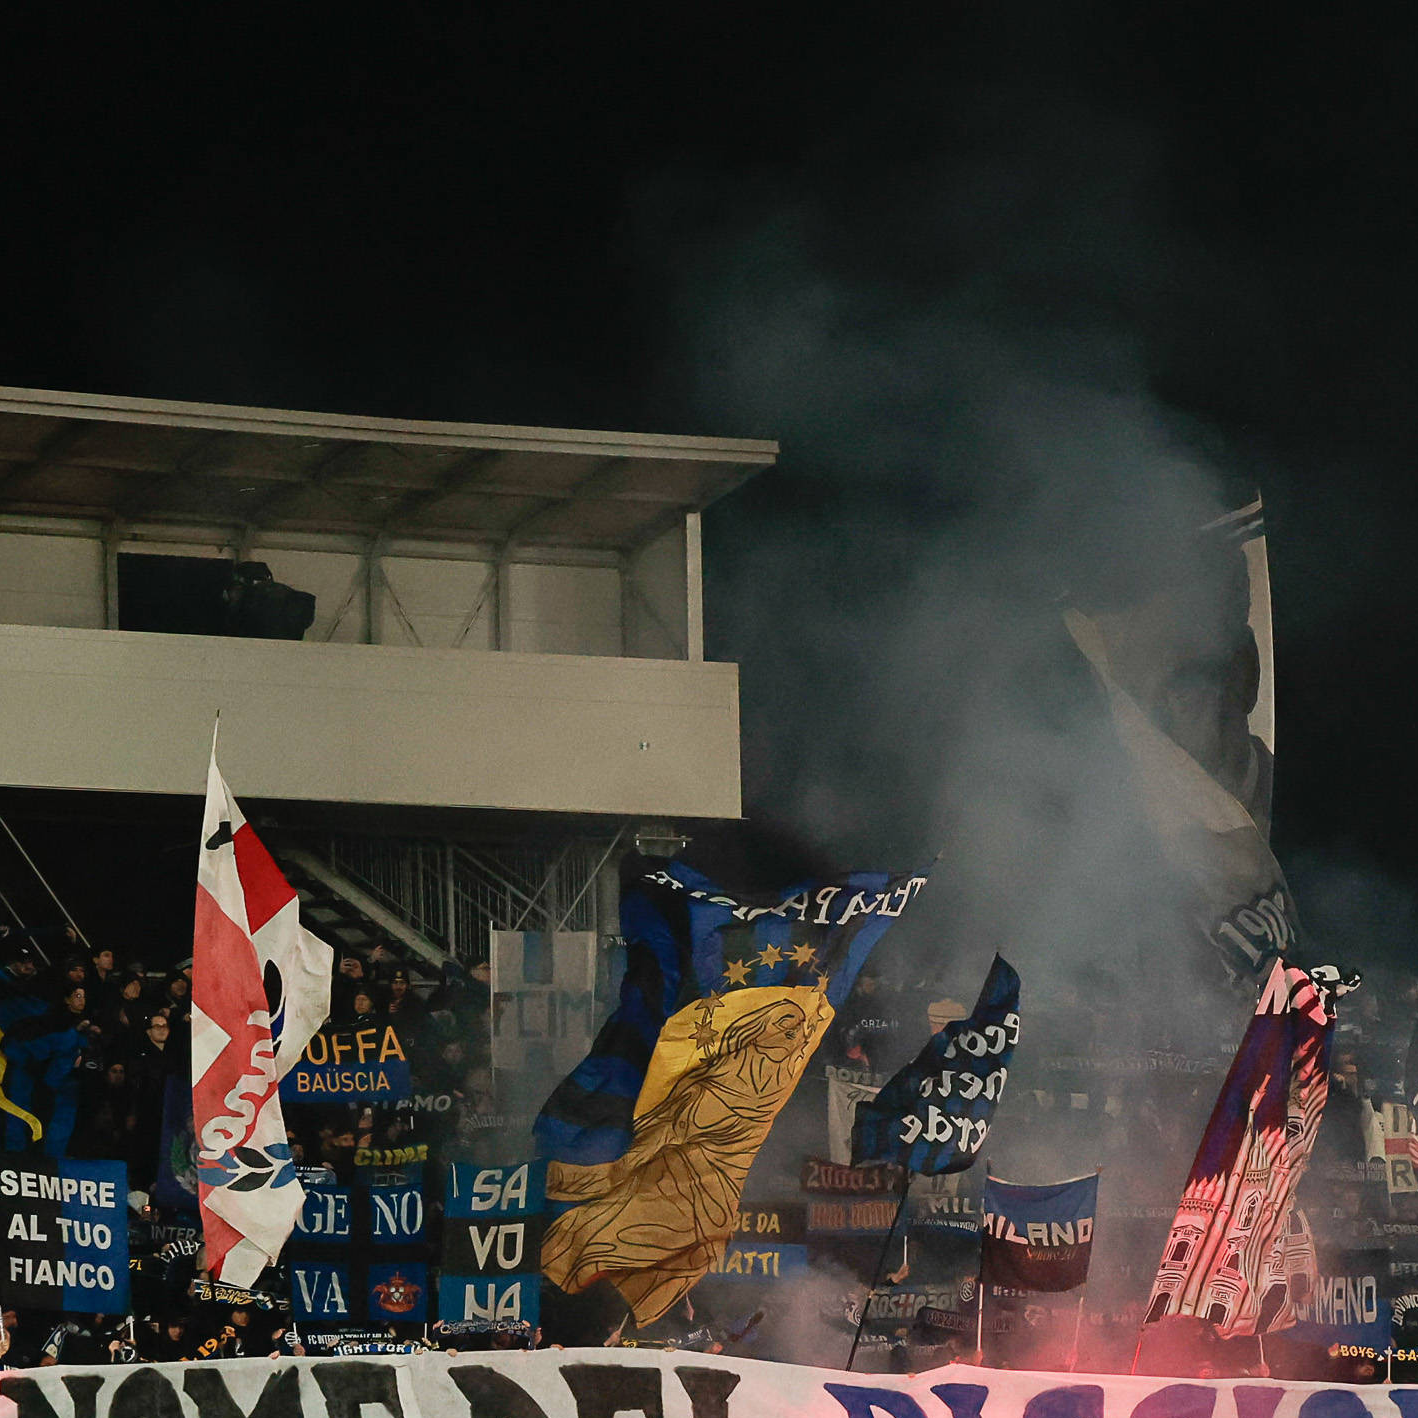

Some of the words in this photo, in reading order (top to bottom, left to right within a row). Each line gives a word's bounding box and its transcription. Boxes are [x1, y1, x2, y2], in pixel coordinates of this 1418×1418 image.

[297, 1068, 391, 1093] BAÜSCIA
[0, 1169, 116, 1209] SEMPRE
[471, 1163, 530, 1211] SA
[8, 1214, 48, 1242] AL
[55, 1216, 113, 1250] TUO
[150, 1224, 197, 1241] INTER
[296, 1192, 351, 1236] GE
[373, 1190, 423, 1234] NO
[469, 1223, 524, 1271] VO
[10, 1256, 115, 1291] FIANCO
[295, 1270, 346, 1315] VA
[464, 1282, 521, 1322] NA
